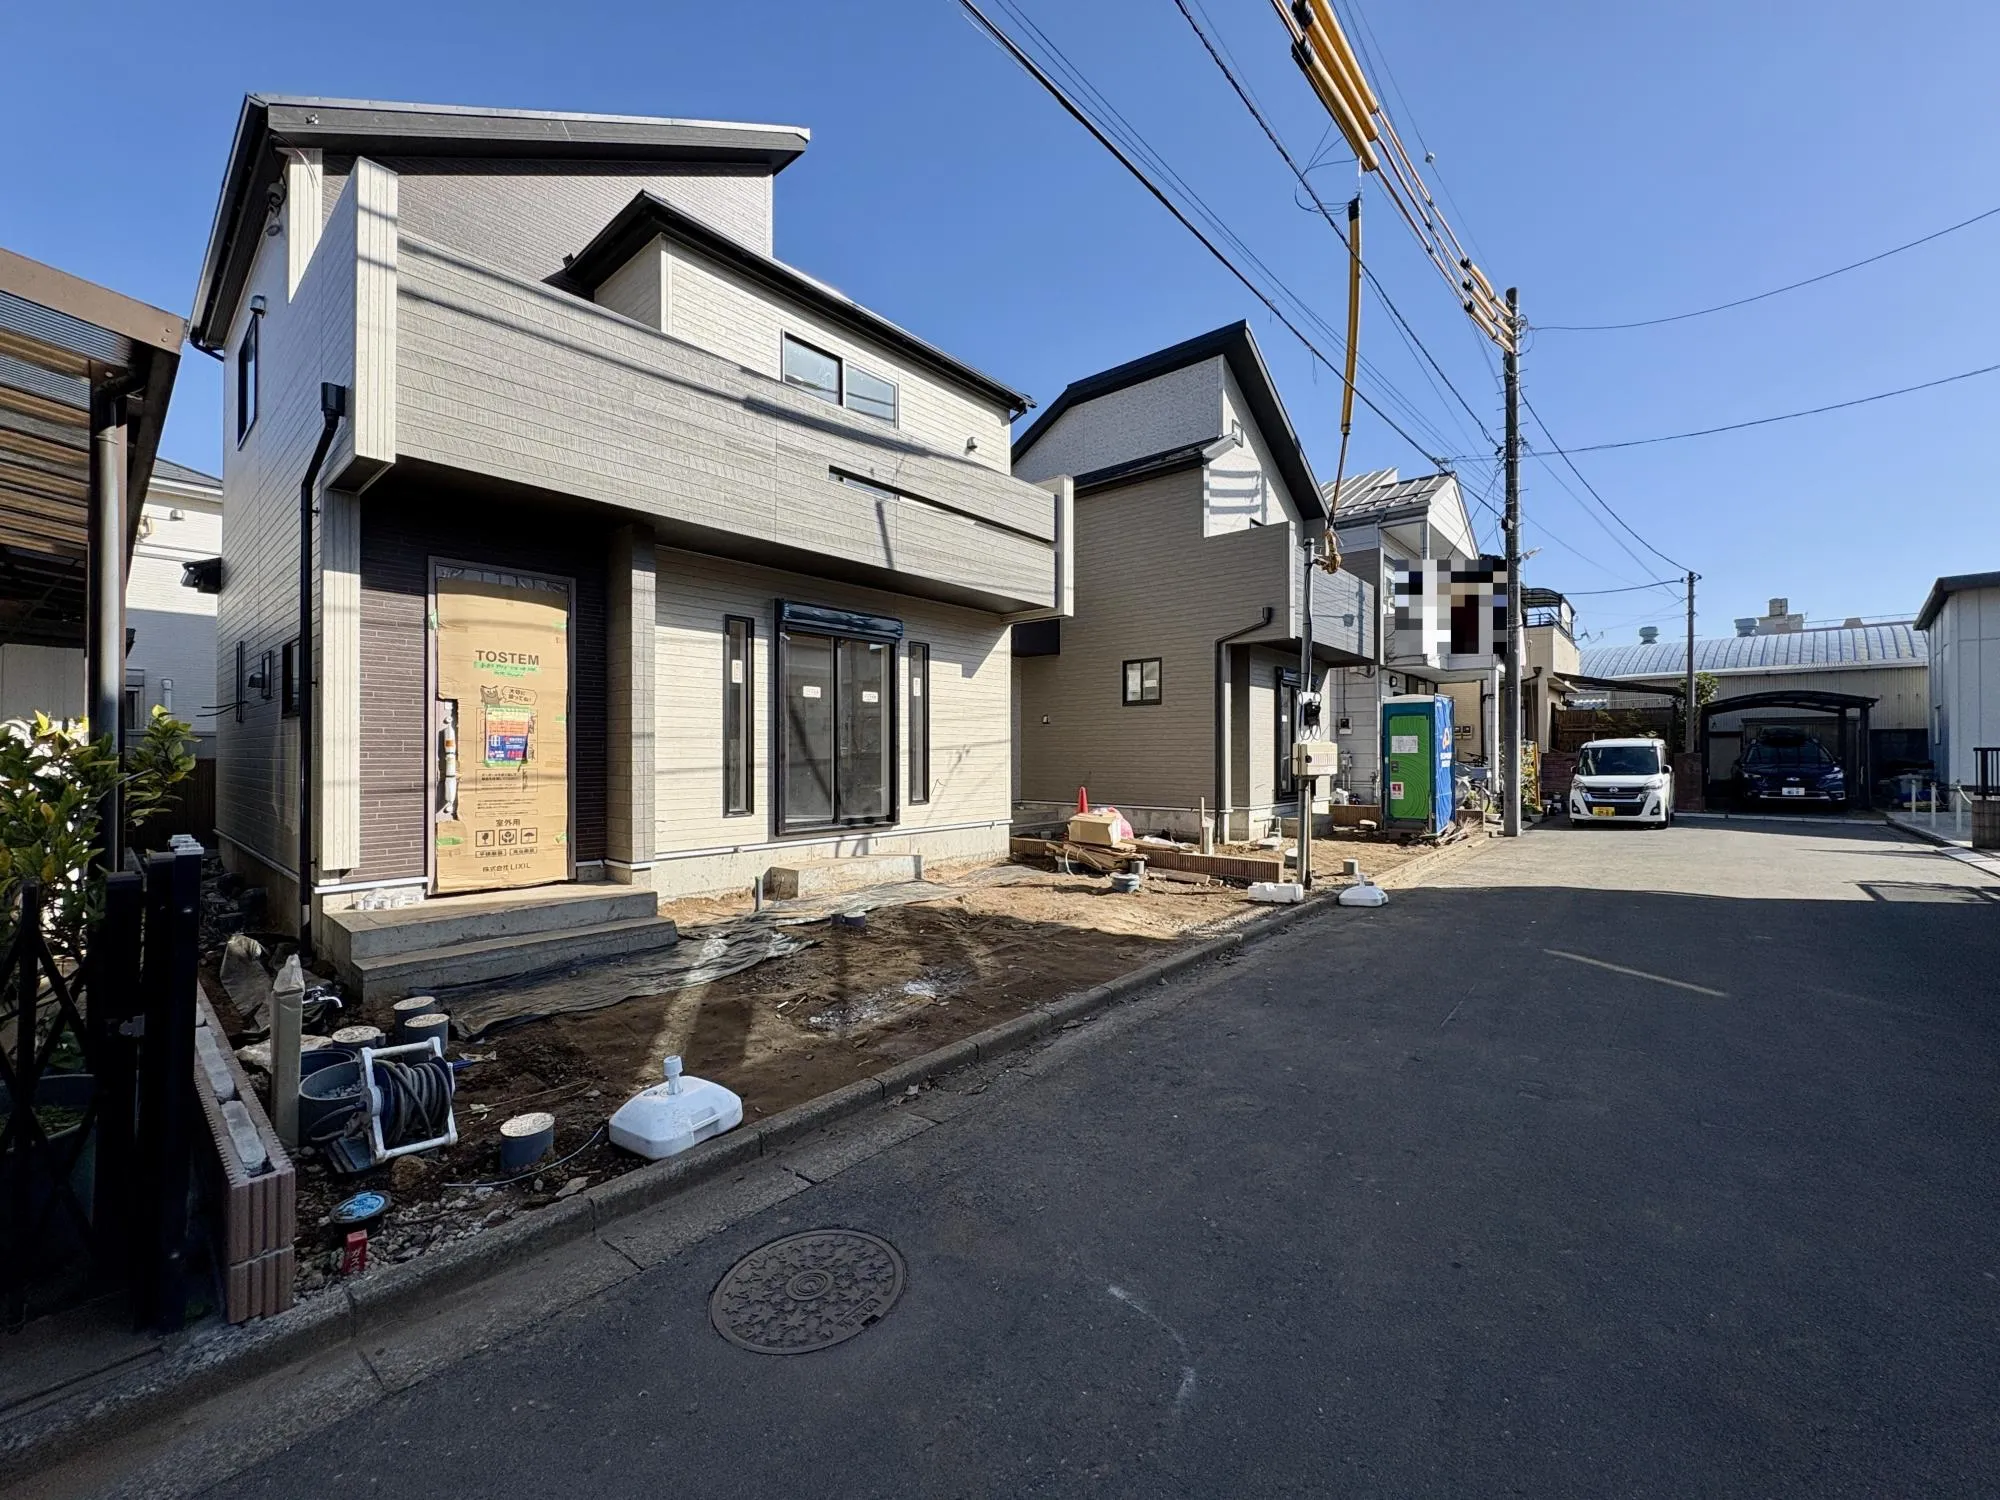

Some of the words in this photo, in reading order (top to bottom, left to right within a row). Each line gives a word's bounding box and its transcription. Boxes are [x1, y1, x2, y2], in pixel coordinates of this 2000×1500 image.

[475, 650, 540, 666] TOSTEM
[495, 818, 521, 827] 室外用
[510, 863, 532, 871] LIXIL
[350, 1246, 362, 1266] ガス
